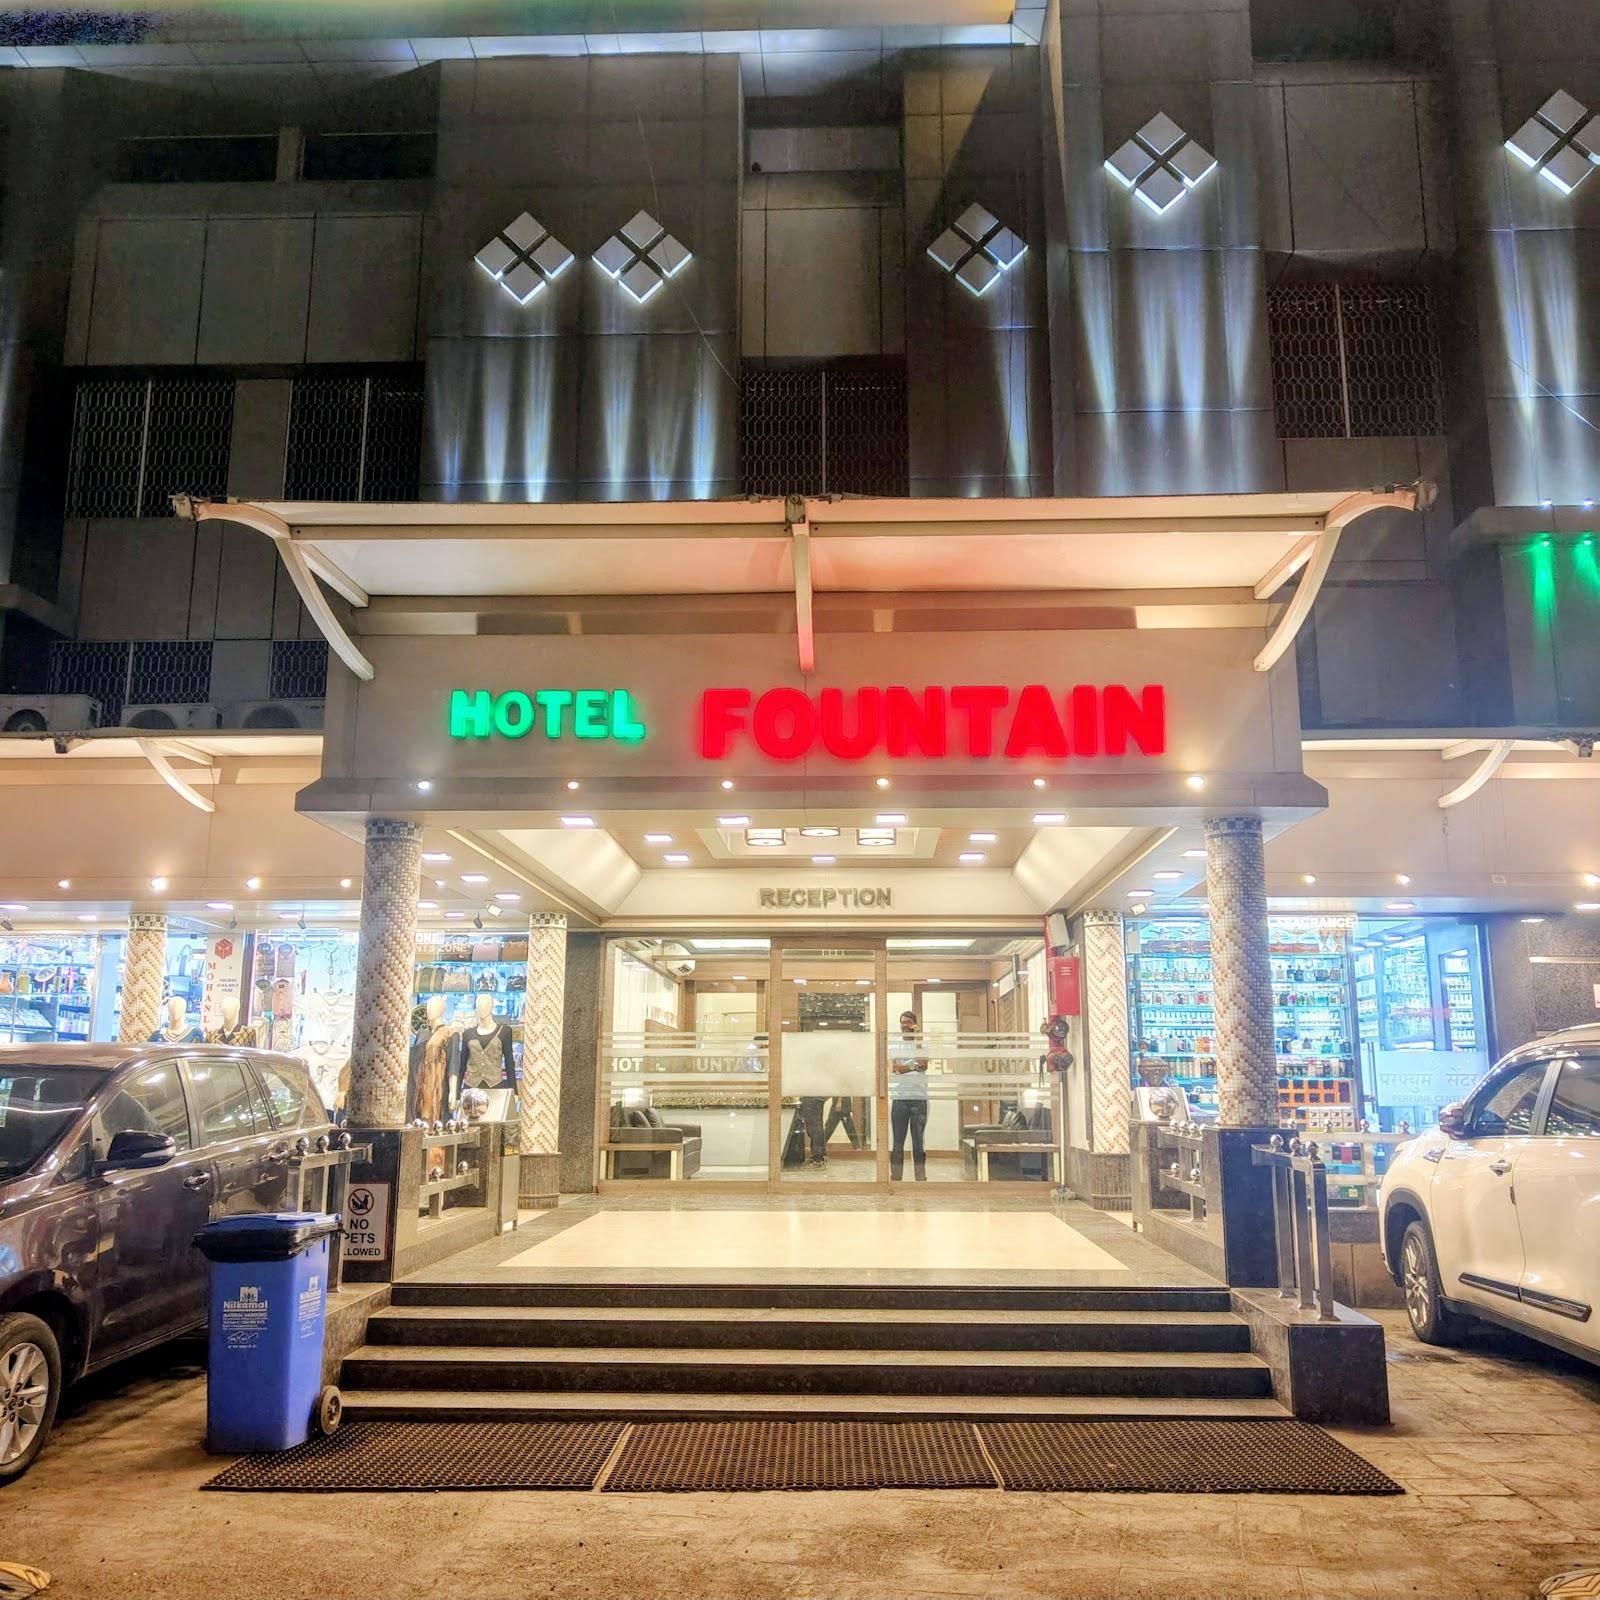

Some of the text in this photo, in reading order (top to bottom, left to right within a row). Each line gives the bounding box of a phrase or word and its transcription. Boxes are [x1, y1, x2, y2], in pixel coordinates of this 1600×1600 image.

[450, 685, 1165, 759] HOTEL FOUNTAIN
[759, 887, 892, 908] RECEPTION
[350, 1219, 369, 1229] NO
[344, 1248, 381, 1256] LOWED
[223, 1300, 268, 1309] Nilkamal
